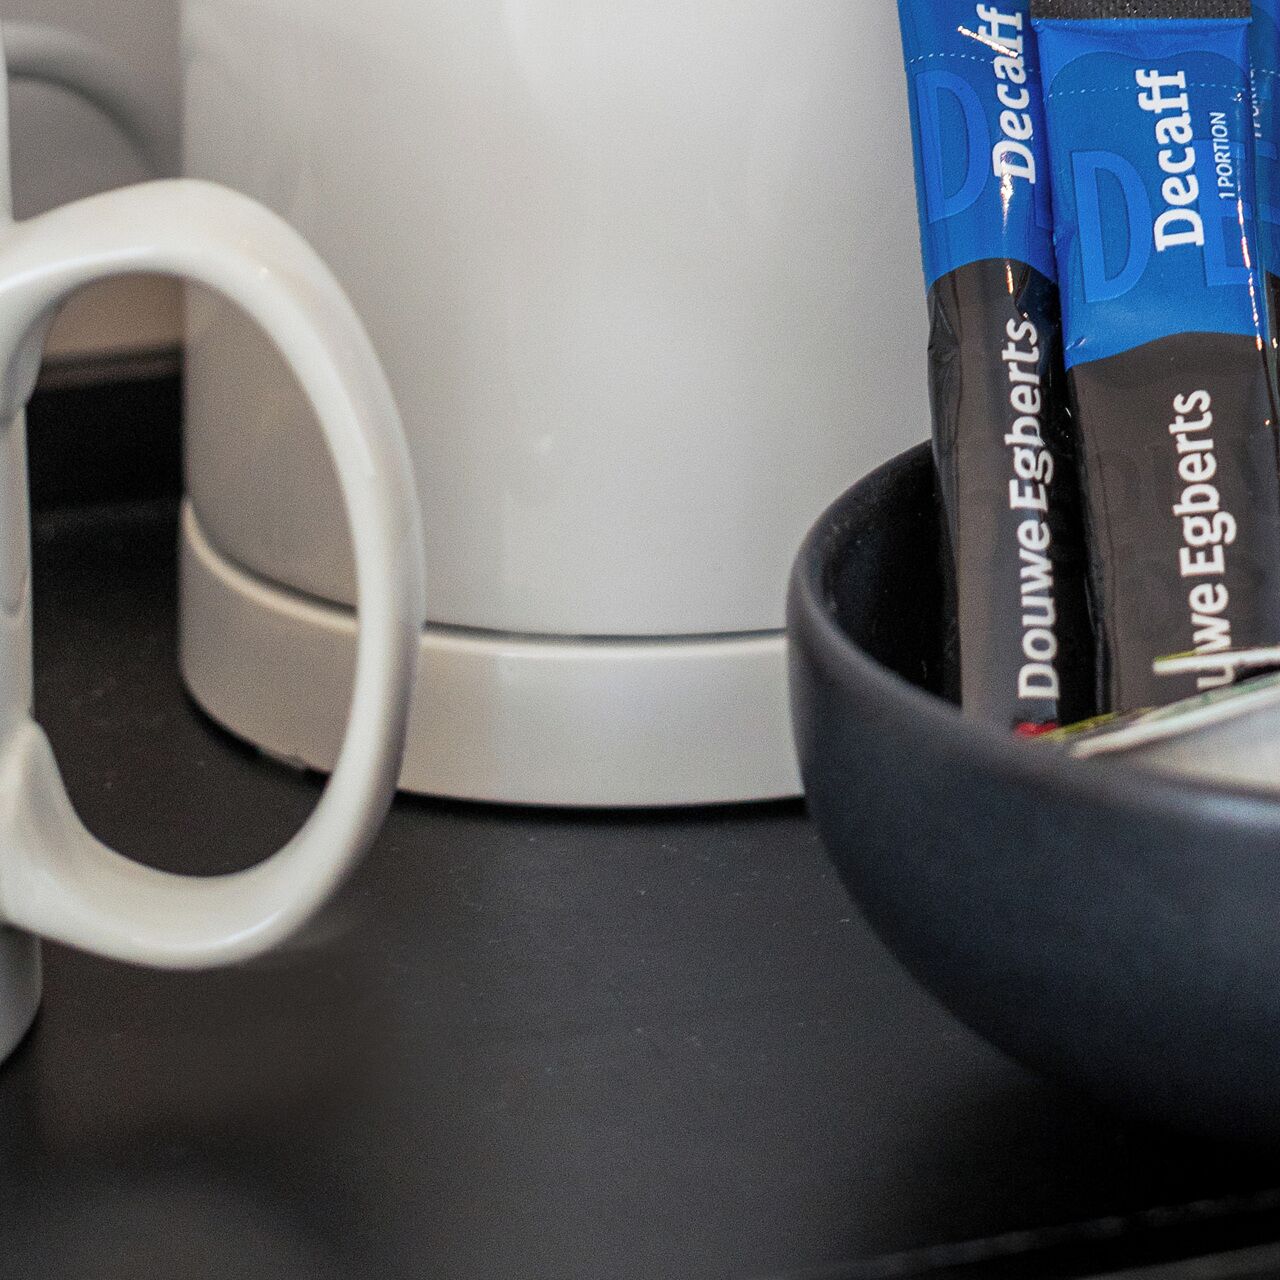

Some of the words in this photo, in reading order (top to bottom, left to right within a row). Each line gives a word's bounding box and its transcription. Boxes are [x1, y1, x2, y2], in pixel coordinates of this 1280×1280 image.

[976, 3, 1036, 184] Decaff
[1135, 68, 1205, 252] Decaff
[1209, 112, 1235, 189] PORTION
[1218, 192, 1235, 200] 1
[1001, 316, 1054, 512] Egberts
[1168, 389, 1237, 576] Egberts
[1017, 519, 1060, 700] Douwe
